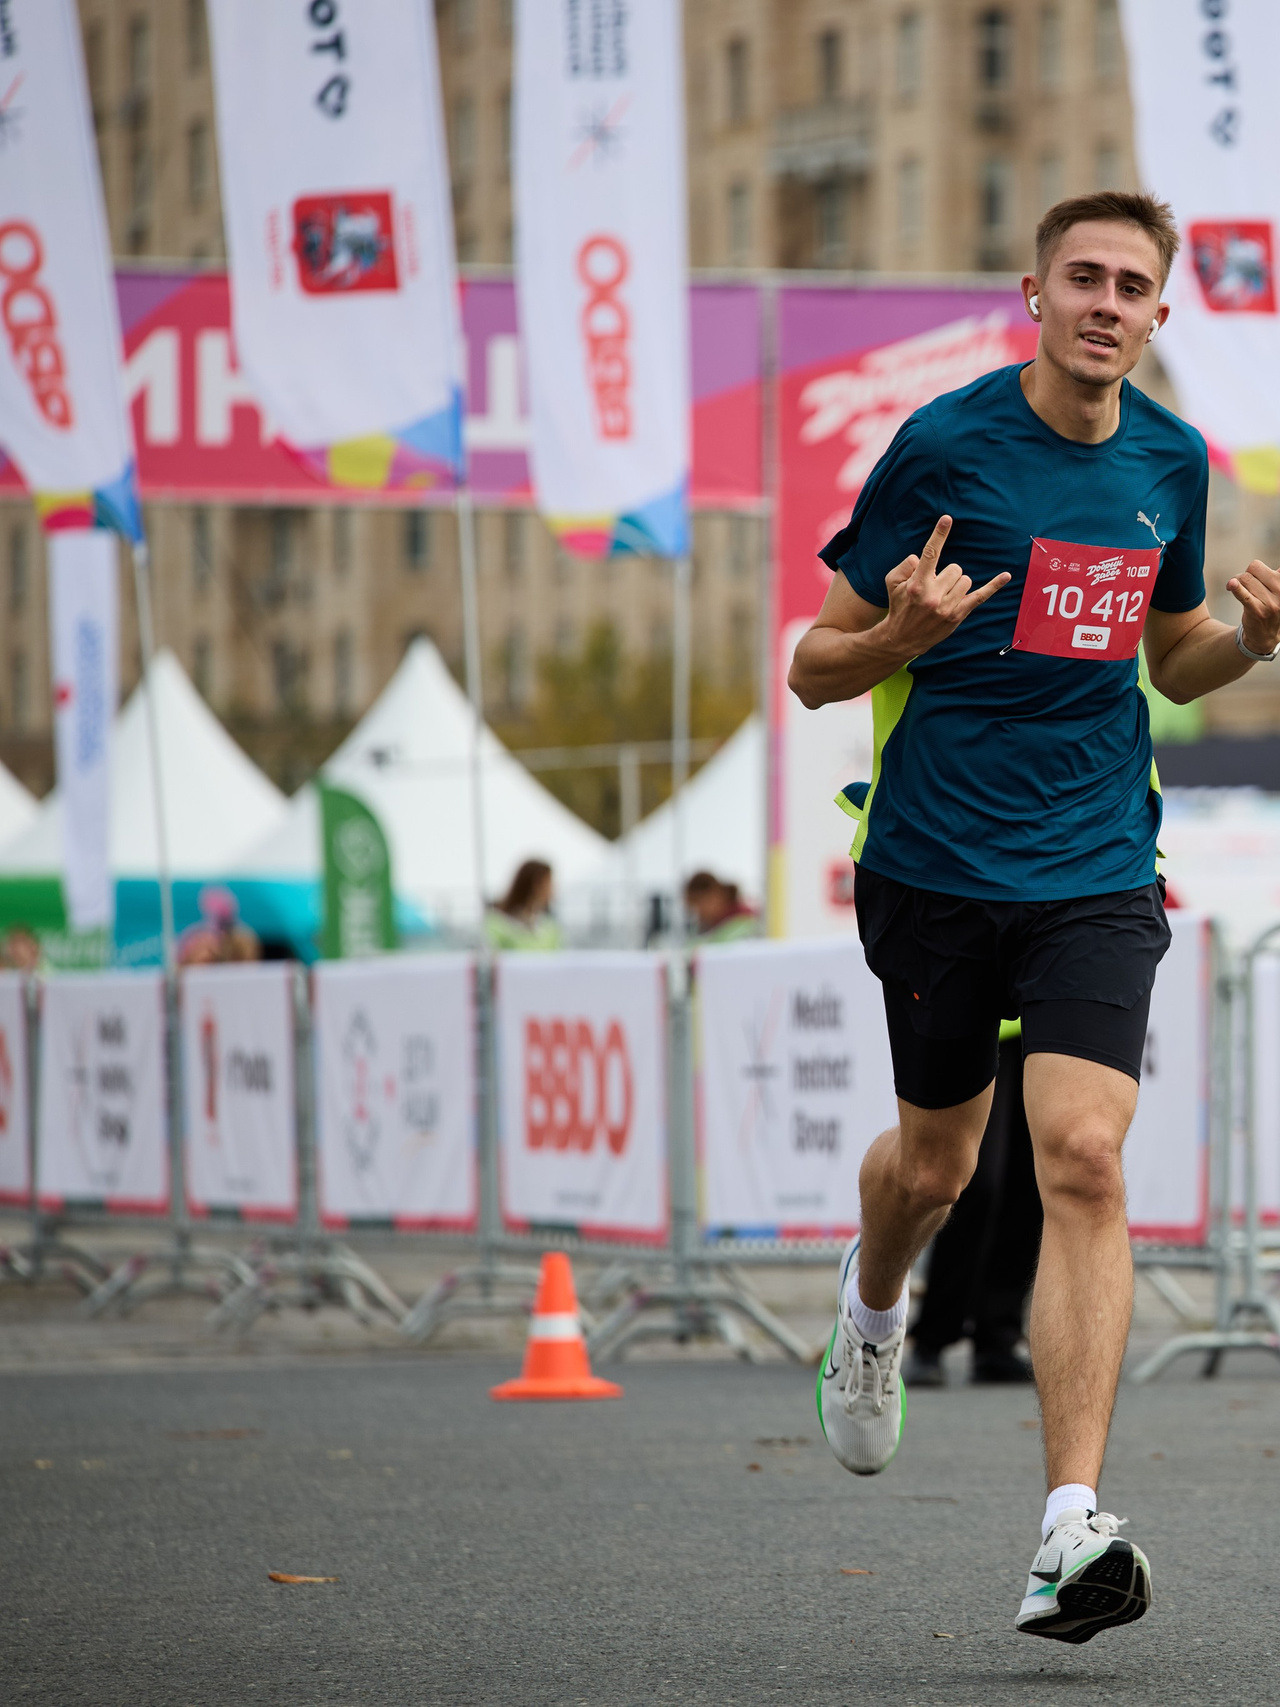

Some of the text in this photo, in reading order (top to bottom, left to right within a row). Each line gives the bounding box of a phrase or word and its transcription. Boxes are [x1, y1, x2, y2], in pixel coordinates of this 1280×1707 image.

[1126, 566, 1138, 578] 10
[1042, 584, 1144, 623] 10 412
[1080, 632, 1103, 642] BBDO
[525, 1014, 634, 1159] BBDO
